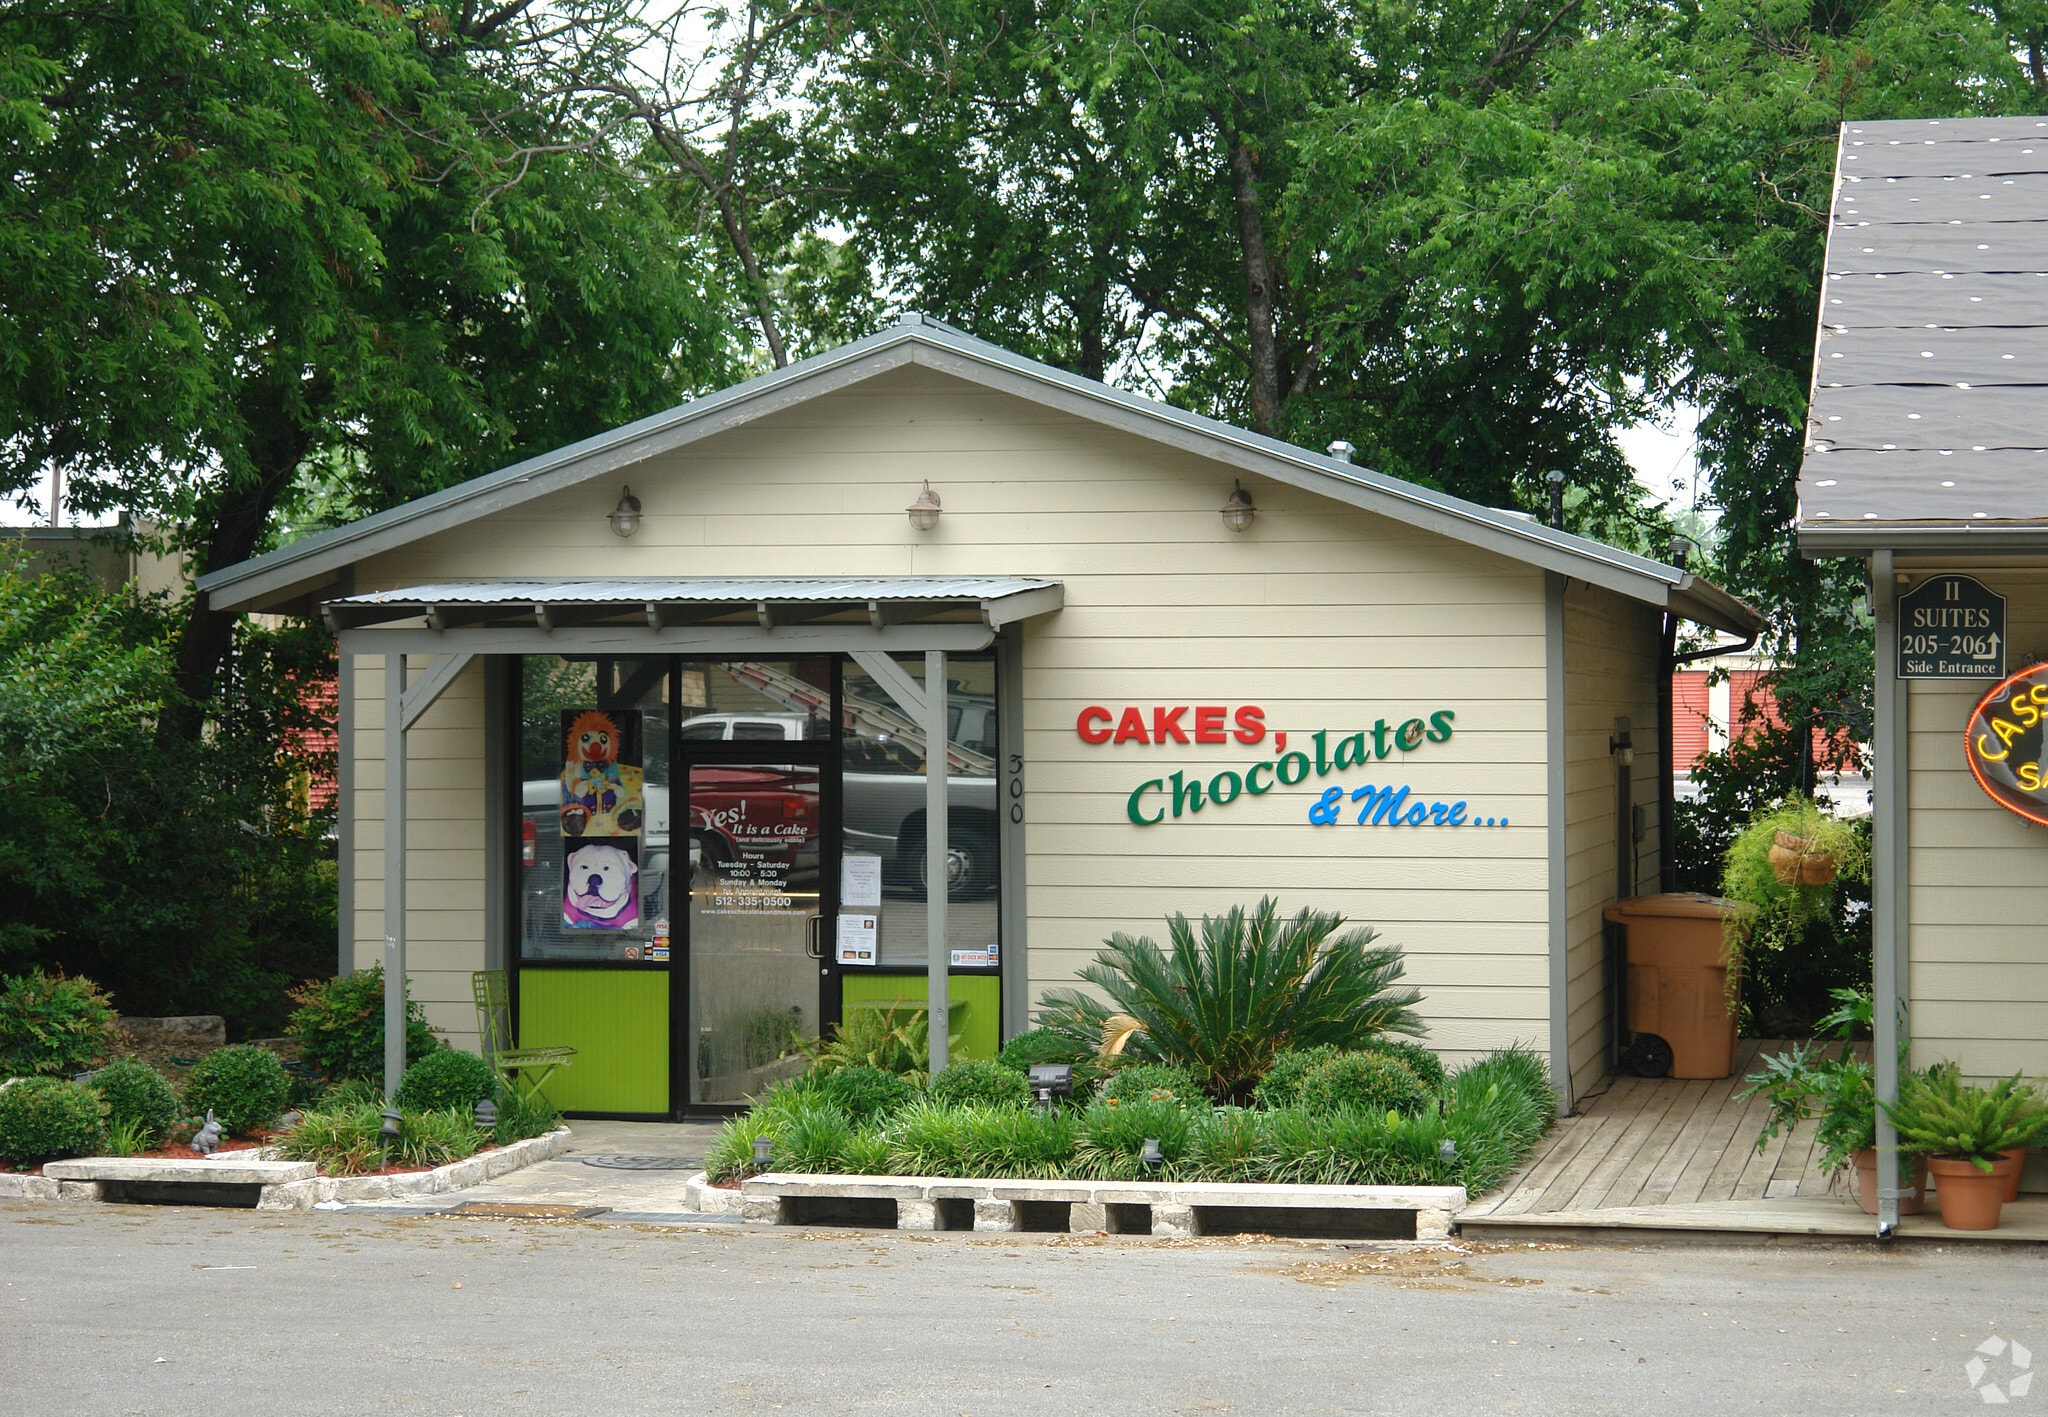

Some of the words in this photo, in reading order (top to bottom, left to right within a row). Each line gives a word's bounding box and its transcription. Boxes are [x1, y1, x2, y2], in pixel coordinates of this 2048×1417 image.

[1914, 608, 1990, 628] SUITES
[1902, 635, 1986, 655] 205-206
[1906, 660, 1933, 673] Side
[1939, 660, 1996, 673] Entrance
[1076, 706, 1288, 753] CAKES,
[1127, 709, 1456, 826] Chocolates
[2016, 762, 2048, 791] S
[1009, 754, 1023, 824] 300
[700, 799, 746, 831] Yes!
[1308, 785, 1344, 827] &
[1351, 784, 1510, 827] More...
[732, 824, 742, 834] It
[746, 824, 757, 834] is
[761, 825, 770, 834] a
[774, 824, 808, 834] Cake
[717, 861, 747, 869] Tuesday
[757, 861, 790, 869] Saturday
[720, 879, 747, 887] Sunday
[758, 879, 787, 887] Monday
[715, 897, 791, 906] 512-335-0500
